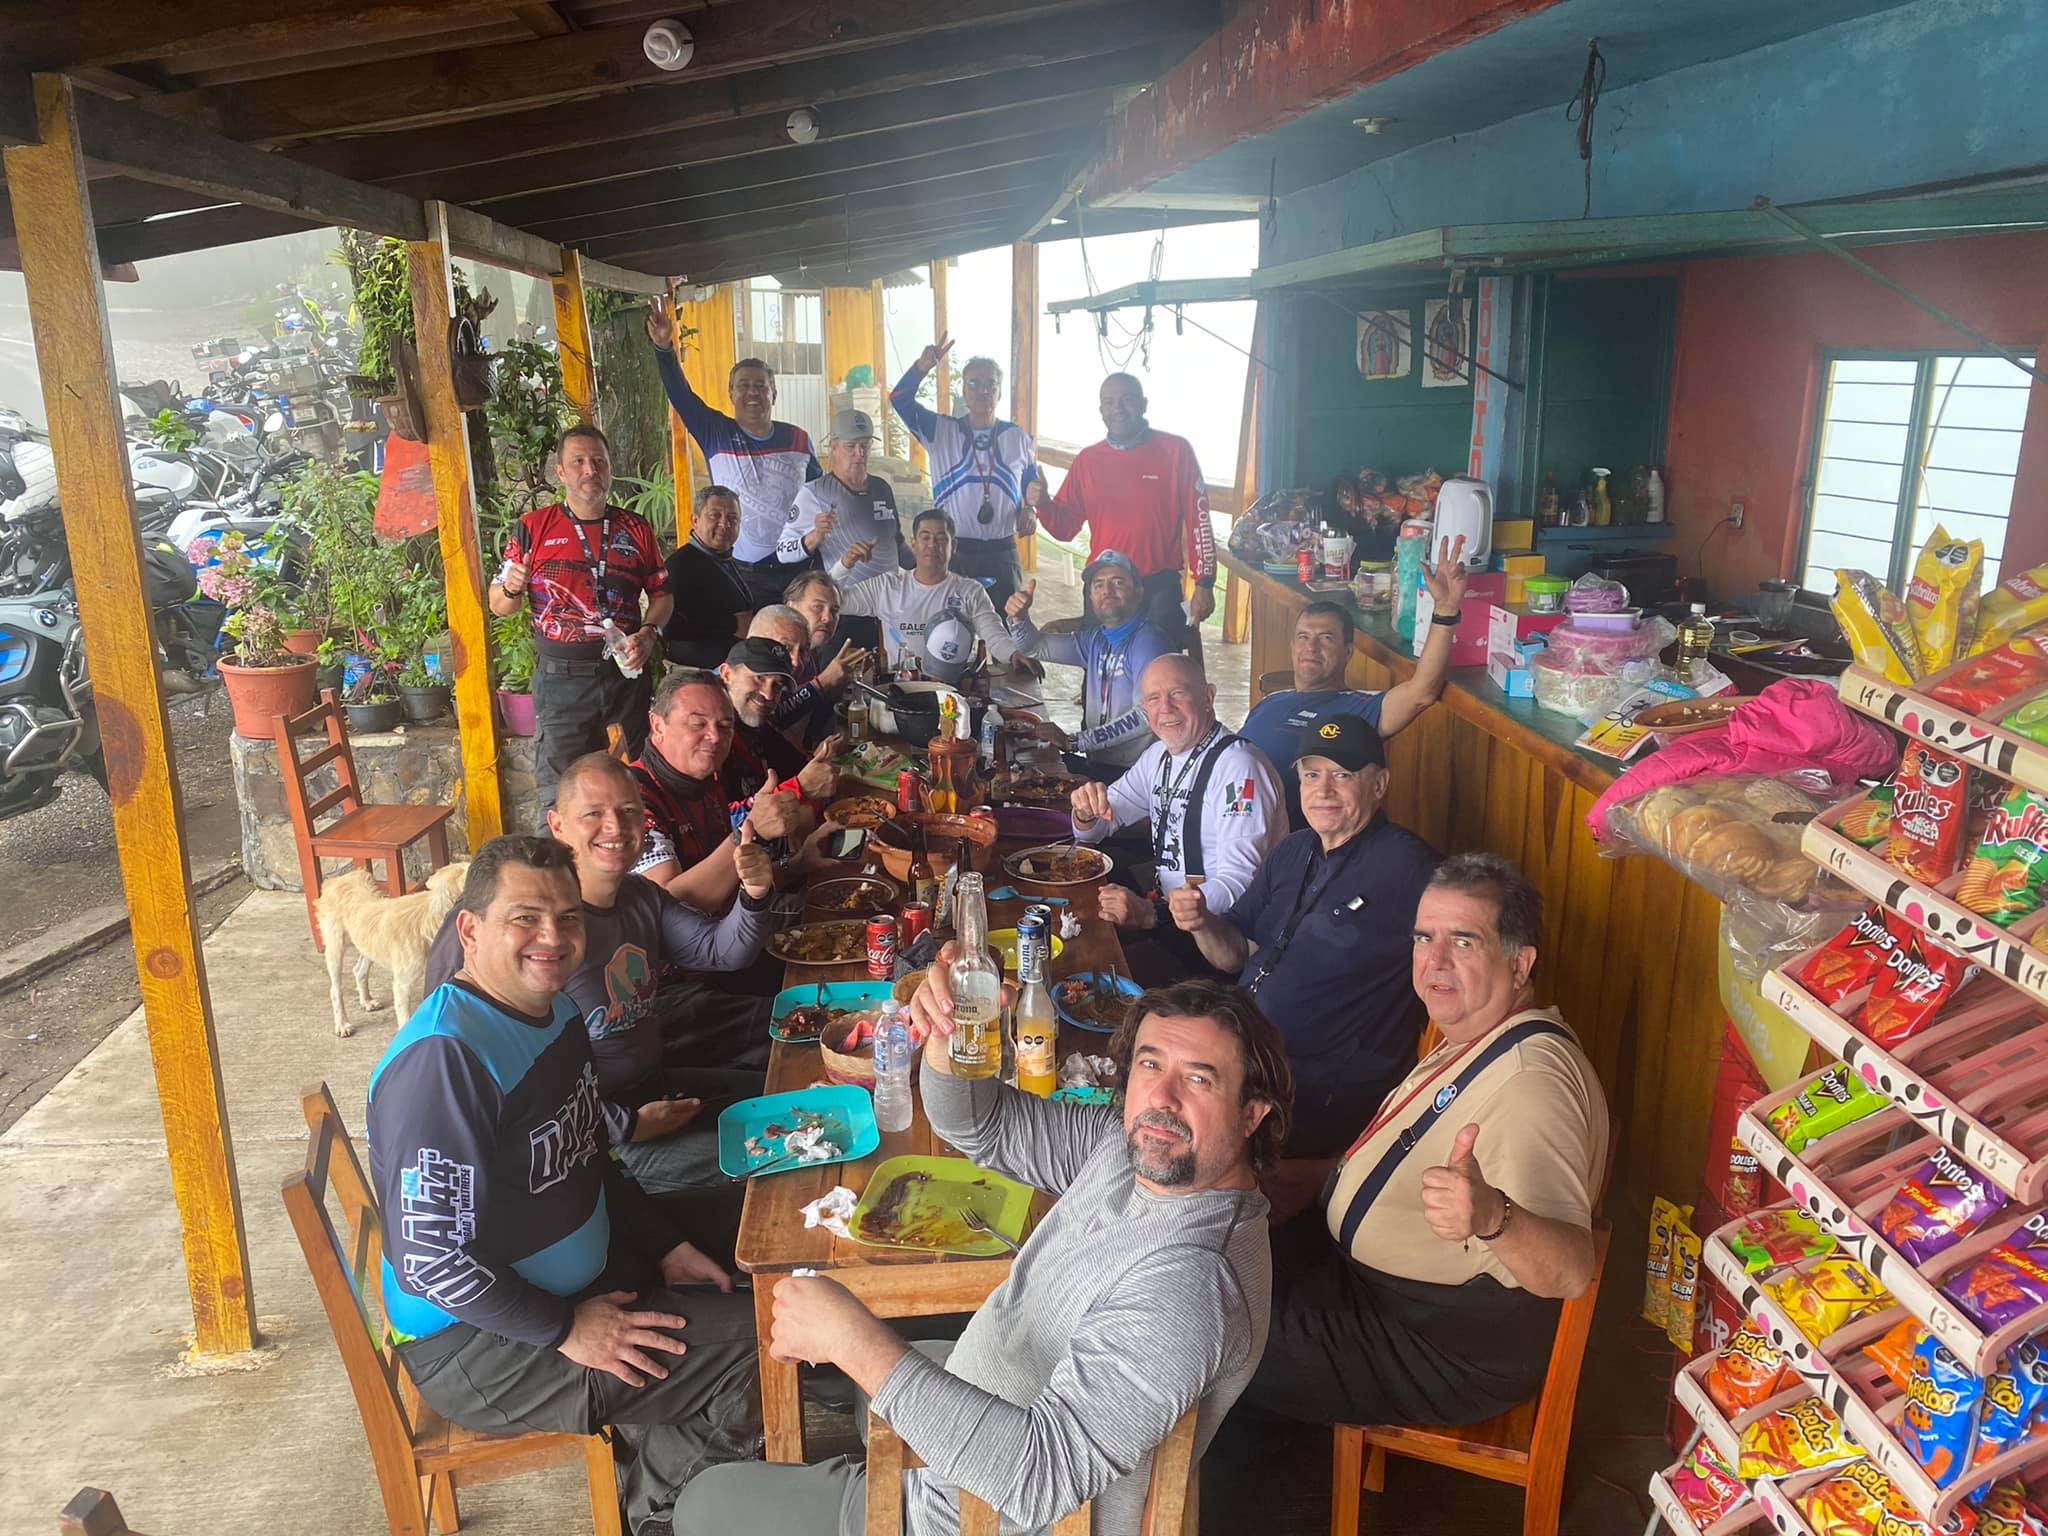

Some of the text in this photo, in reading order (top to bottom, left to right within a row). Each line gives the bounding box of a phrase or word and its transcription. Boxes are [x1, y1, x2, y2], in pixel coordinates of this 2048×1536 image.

[1196, 496, 1214, 576] Columbia
[1094, 710, 1141, 744] BMW
[1886, 948, 1944, 991] Doritos
